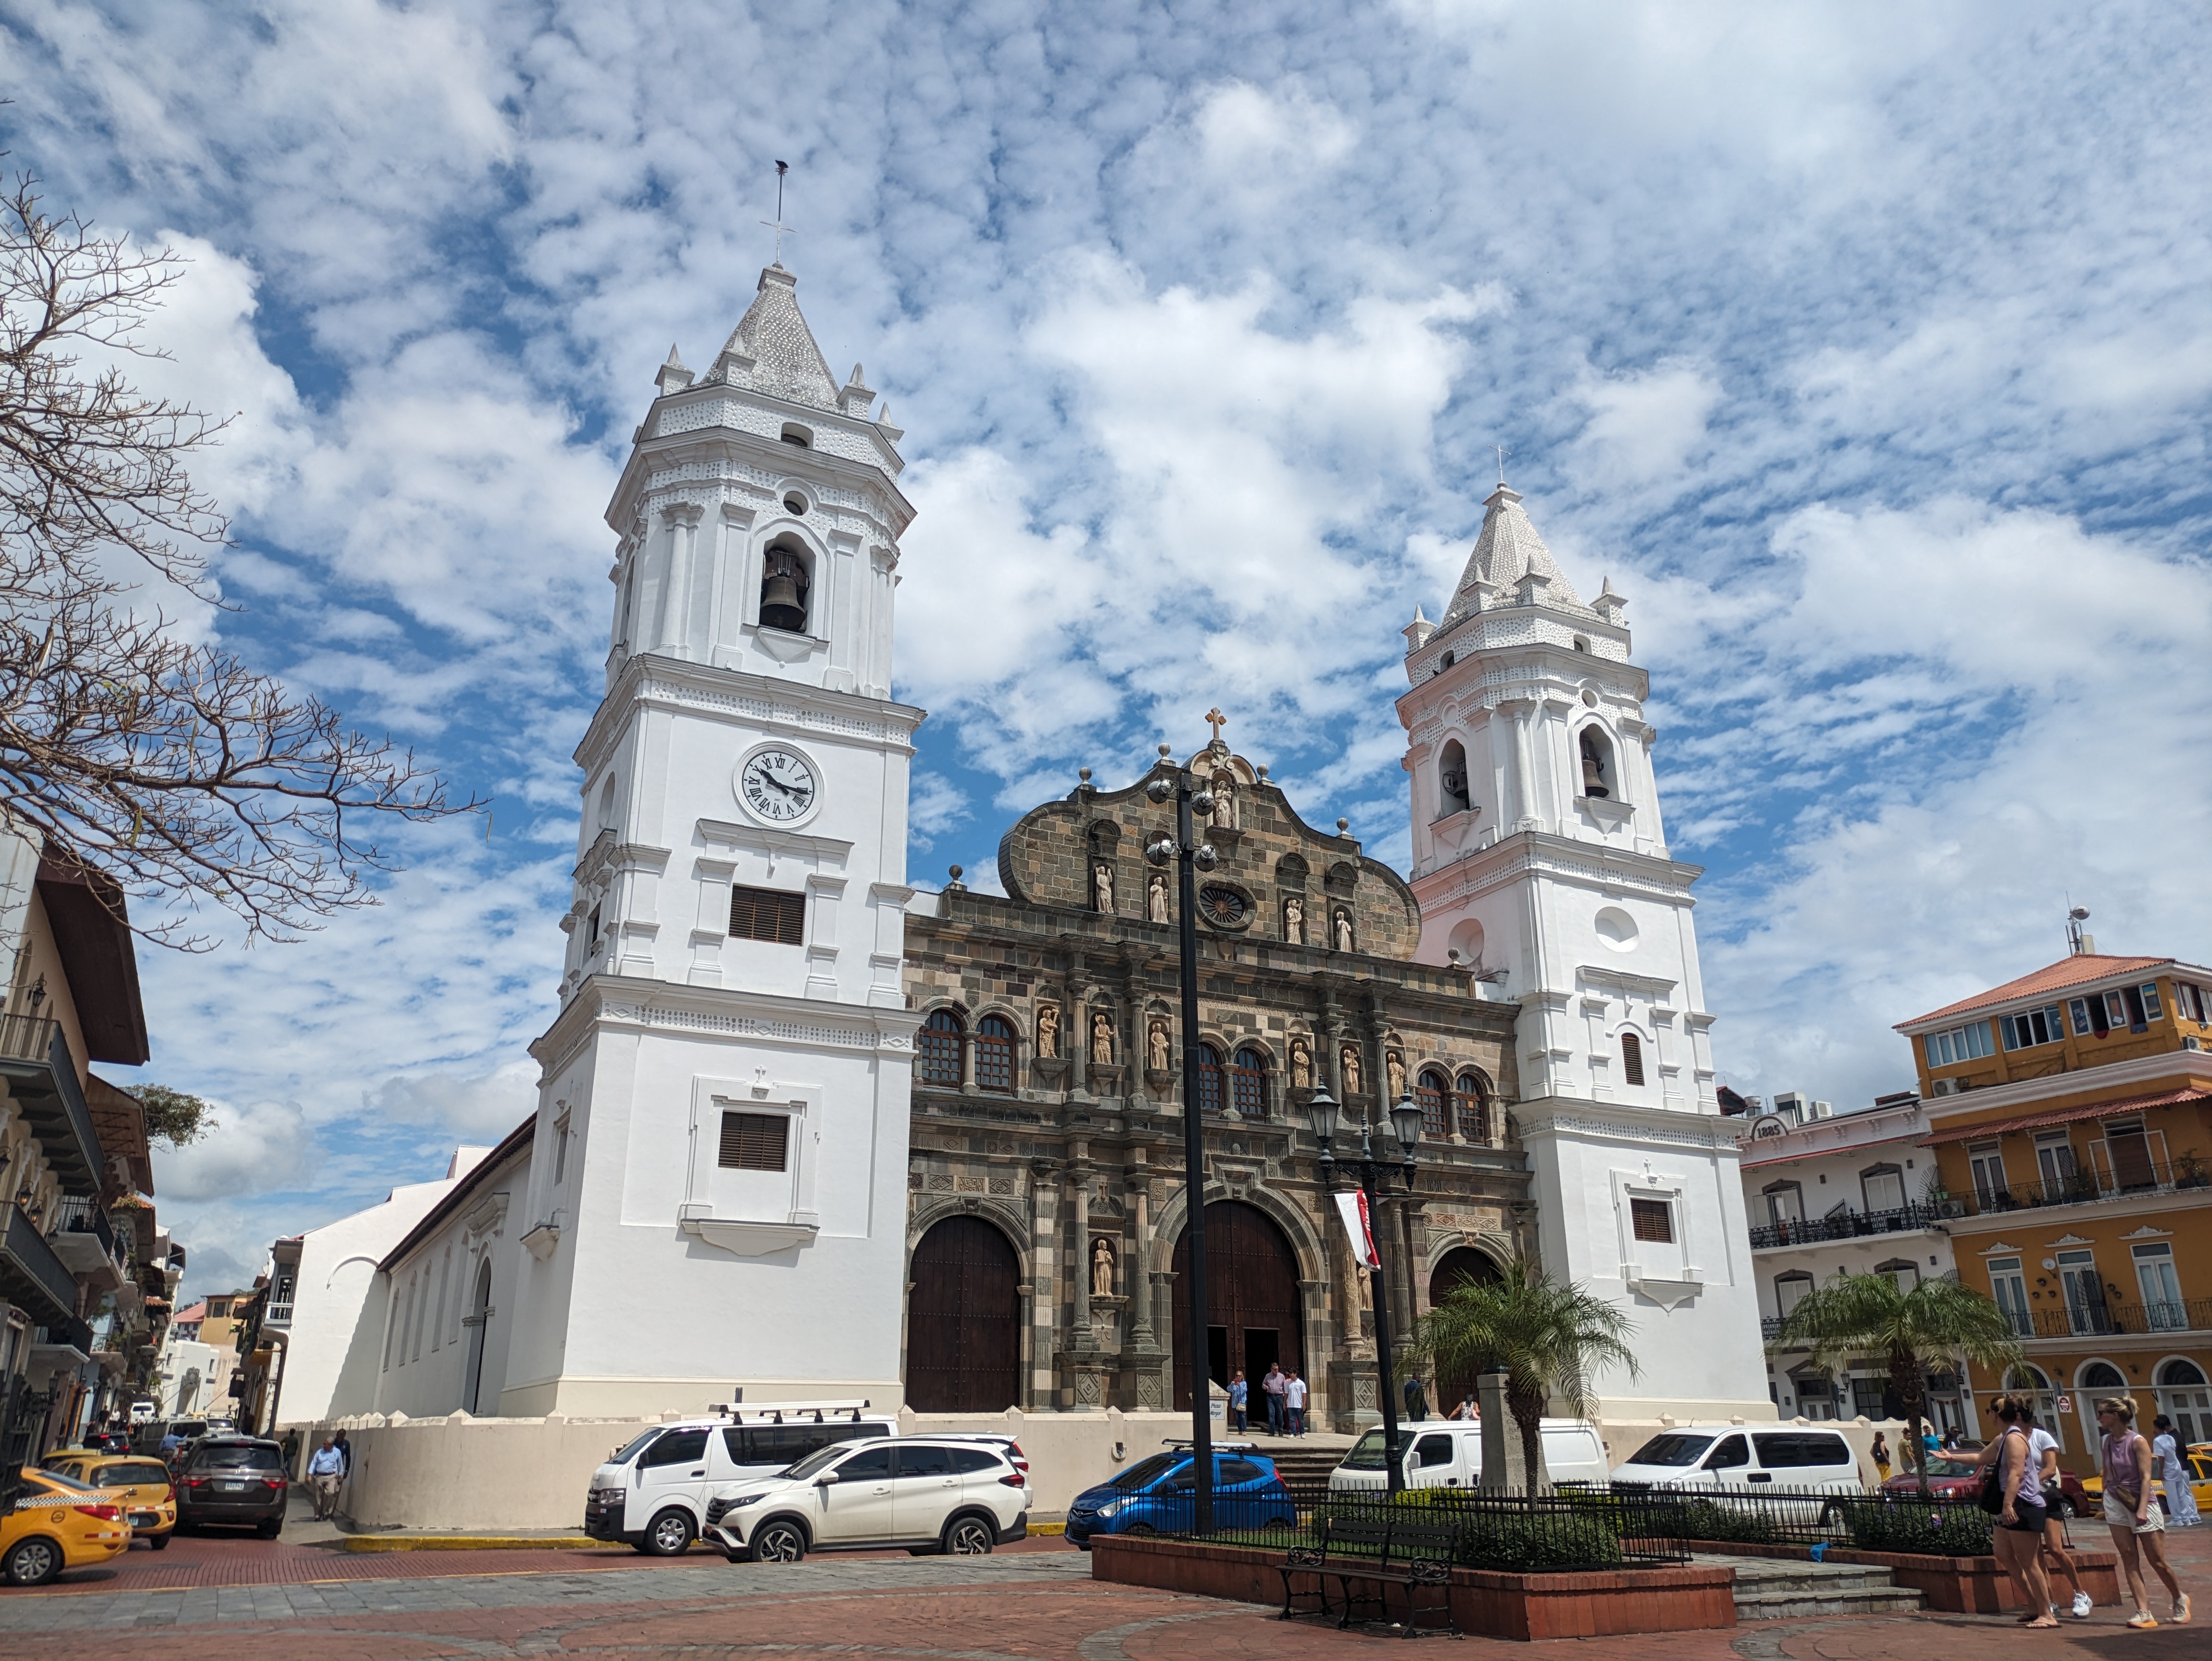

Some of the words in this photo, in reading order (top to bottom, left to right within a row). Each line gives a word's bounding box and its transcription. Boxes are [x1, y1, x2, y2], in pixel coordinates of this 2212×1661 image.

[761, 758, 773, 770] XI
[774, 757, 785, 769] XII
[788, 763, 796, 773] I
[752, 765, 763, 775] X
[749, 776, 760, 785] IX
[749, 787, 763, 802] VIII
[758, 797, 771, 811] VII
[772, 803, 781, 815] VI
[786, 803, 795, 814] V
[1756, 1125, 1780, 1138] 1885
